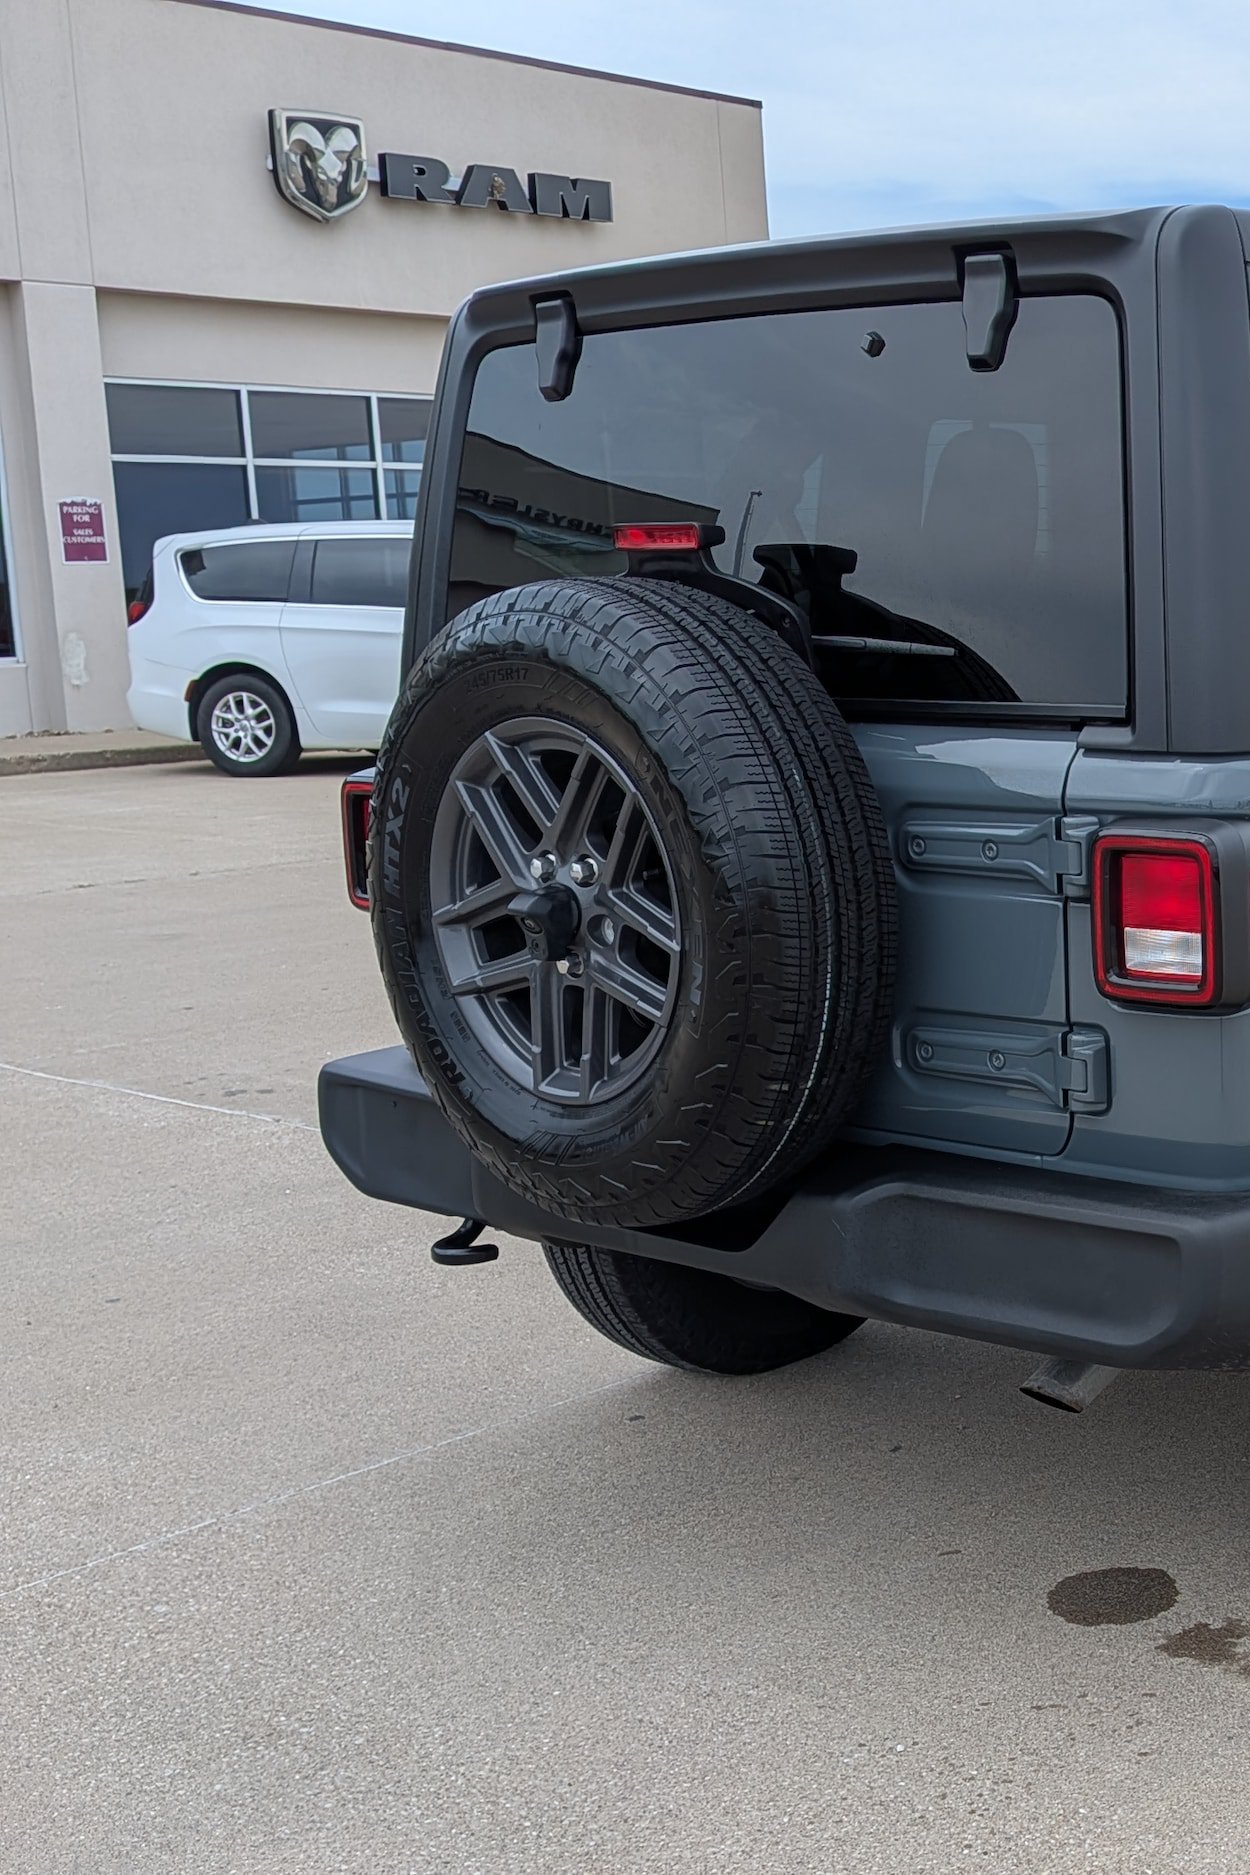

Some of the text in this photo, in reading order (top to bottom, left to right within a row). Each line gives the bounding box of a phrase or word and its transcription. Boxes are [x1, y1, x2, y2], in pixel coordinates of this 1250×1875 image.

[378, 152, 614, 223] RAM
[63, 506, 98, 514] PARKING
[73, 514, 90, 522] FOR
[63, 536, 105, 544] CUSTOMERS
[464, 667, 529, 692] 245/75R17
[382, 775, 410, 900] HTX2
